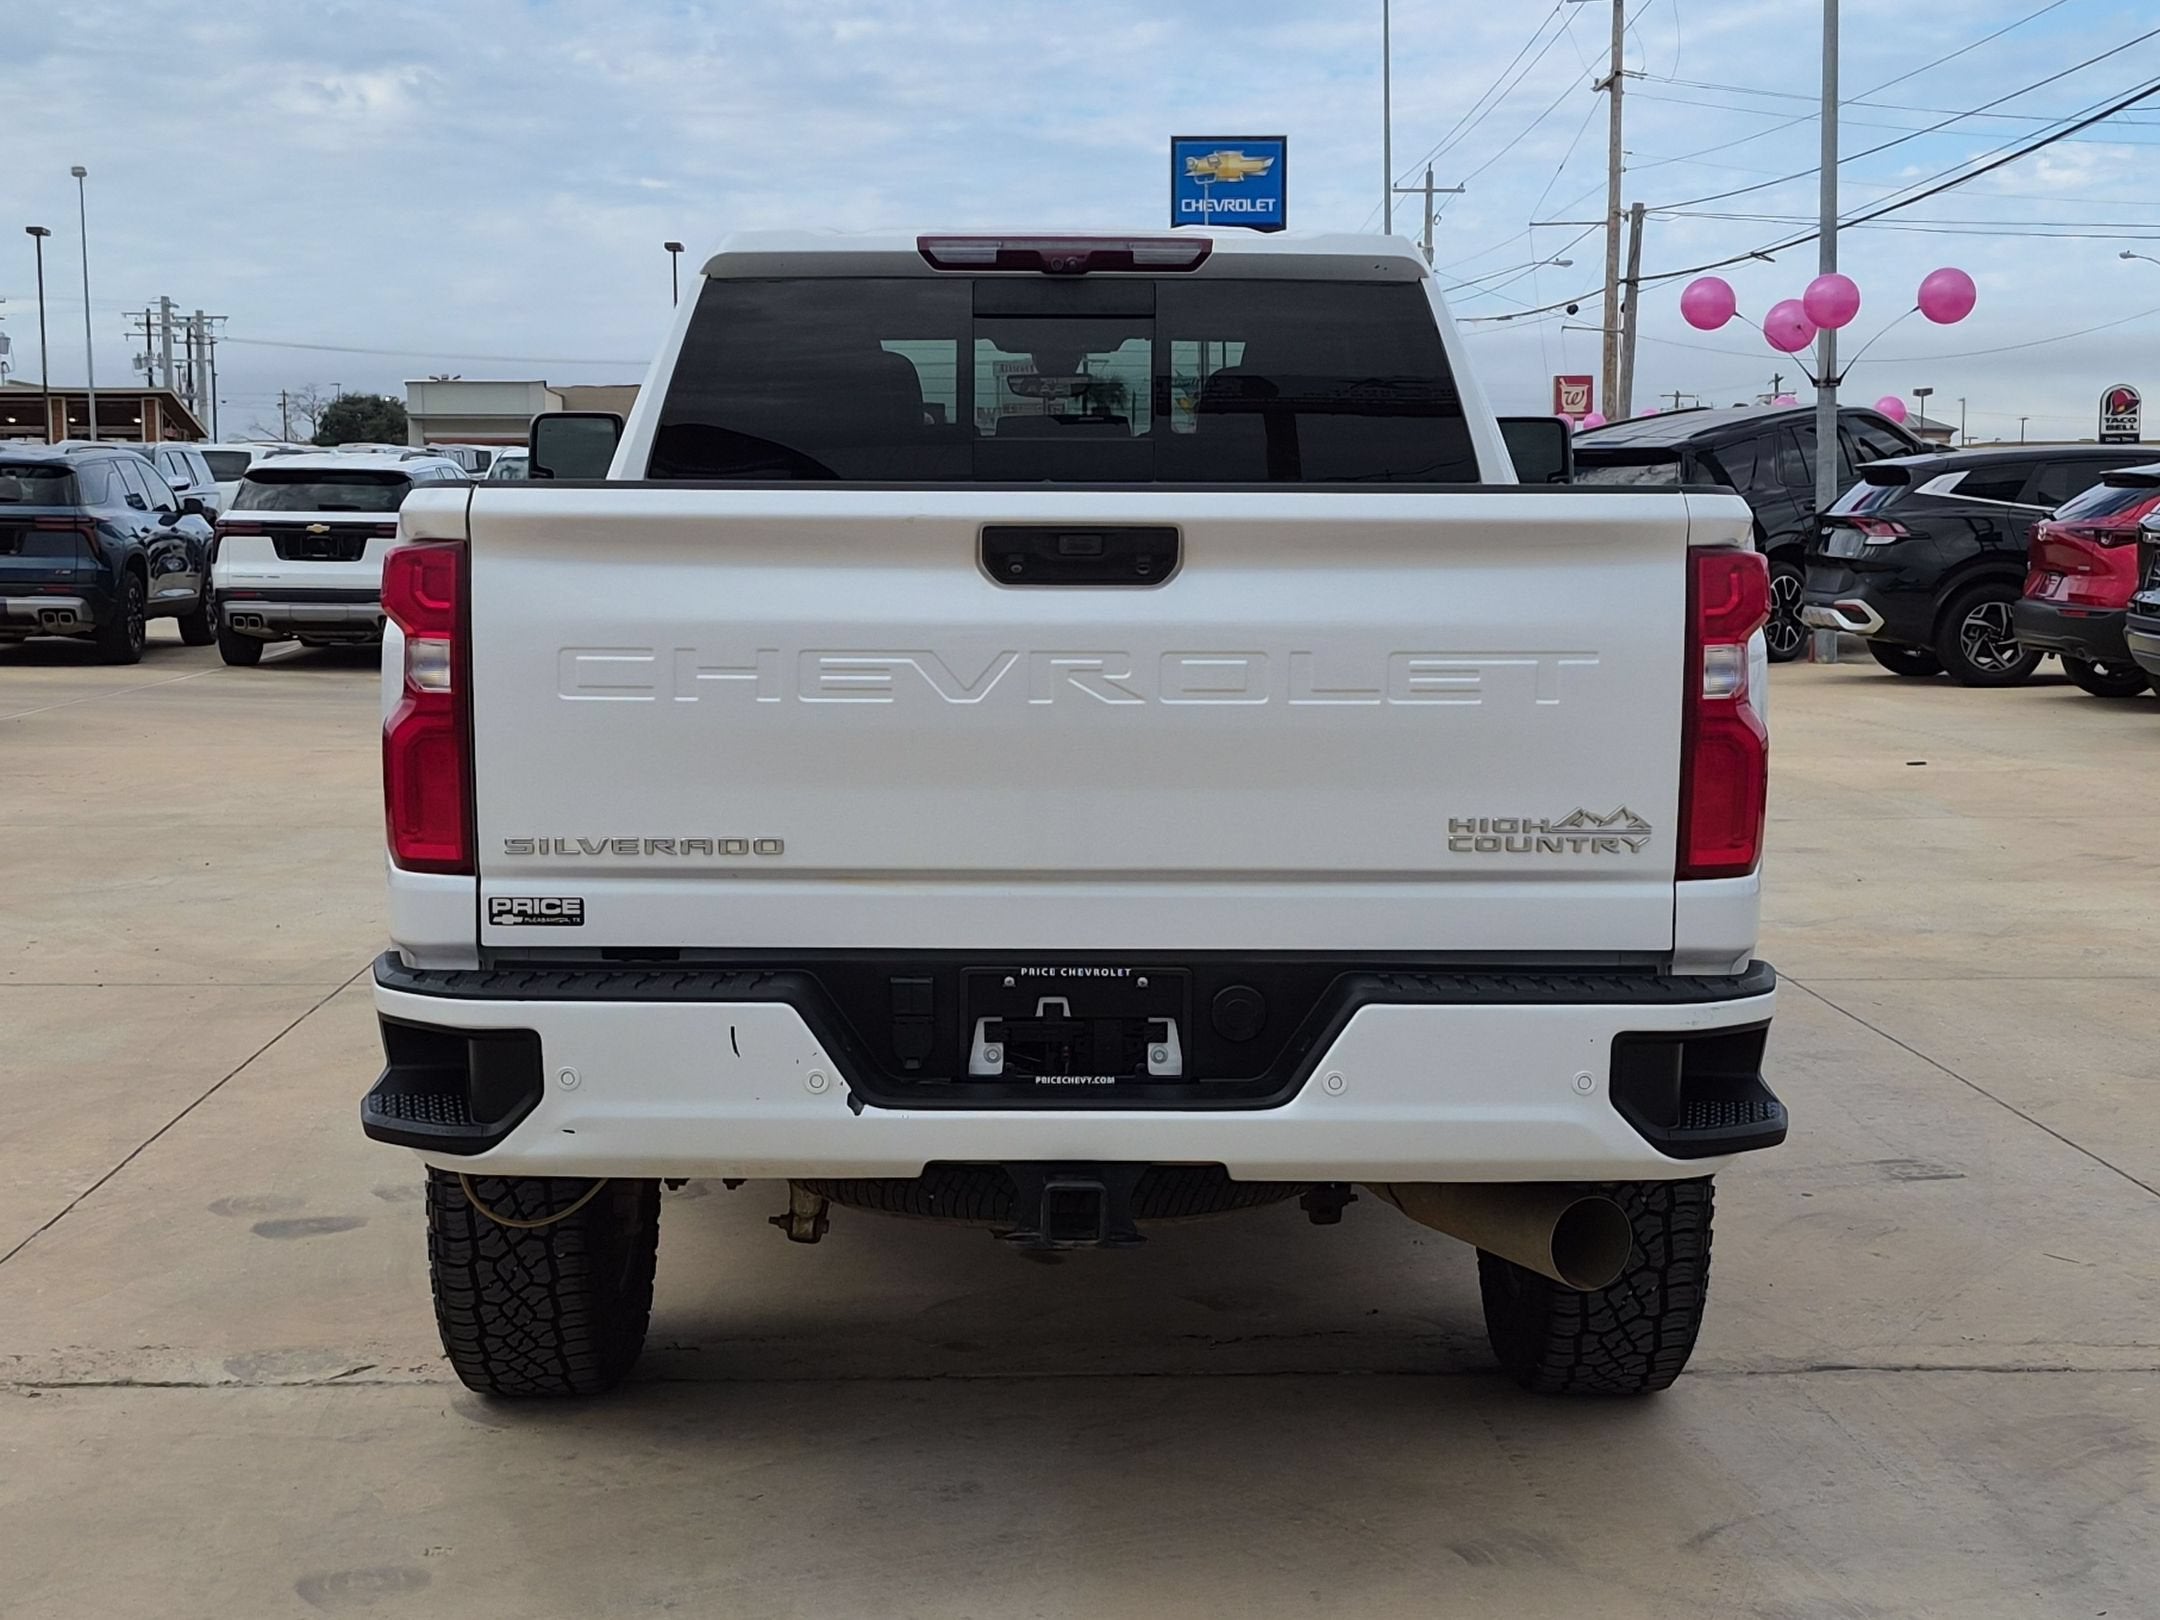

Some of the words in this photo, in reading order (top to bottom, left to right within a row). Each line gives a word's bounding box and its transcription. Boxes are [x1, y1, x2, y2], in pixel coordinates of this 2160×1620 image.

[1181, 198, 1276, 212] CHEVROLET
[558, 647, 1600, 706] CHEVROLET
[1448, 818, 1551, 834] HIGH
[503, 837, 785, 856] SILVERADO
[1448, 836, 1651, 854] COUNTRY
[492, 899, 581, 915] PRICE
[1020, 967, 1056, 977] PRICE
[1060, 967, 1132, 977] CHEVROLET
[1035, 1076, 1115, 1085] PRICECHEVY.COM
